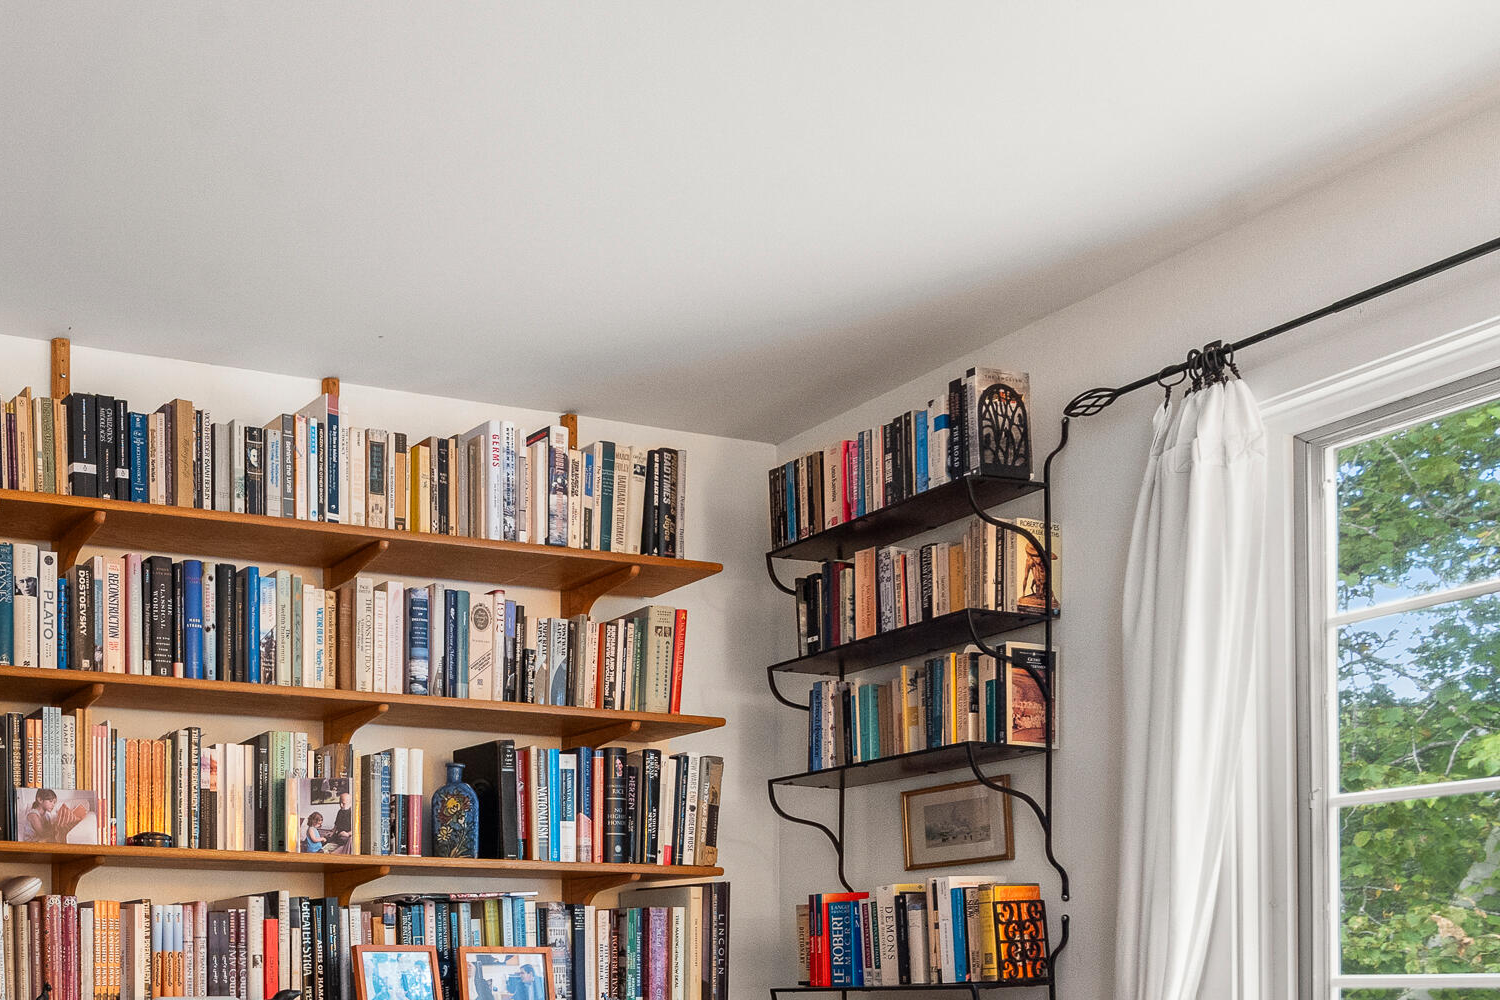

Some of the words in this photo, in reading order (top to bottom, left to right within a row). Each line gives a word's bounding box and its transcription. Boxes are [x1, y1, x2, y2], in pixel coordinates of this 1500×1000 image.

[617, 475, 625, 505] BARBARA
[616, 514, 624, 545] TUCHMAN
[44, 590, 54, 639] PLATO
[79, 570, 87, 635] DOSTOEVSKY
[109, 573, 119, 638] RECONSTRUCTION
[690, 757, 699, 771] HOW
[690, 773, 698, 789] WARS
[689, 791, 697, 802] END
[538, 787, 548, 838] NATIONALISM
[688, 814, 696, 835] GIDEON
[302, 902, 311, 944] GREATER
[885, 906, 895, 960] DEMONS
[831, 916, 844, 964] ROBERT
[302, 947, 312, 975] SYRIA
[318, 964, 323, 974] OF
[834, 969, 844, 983] LE
